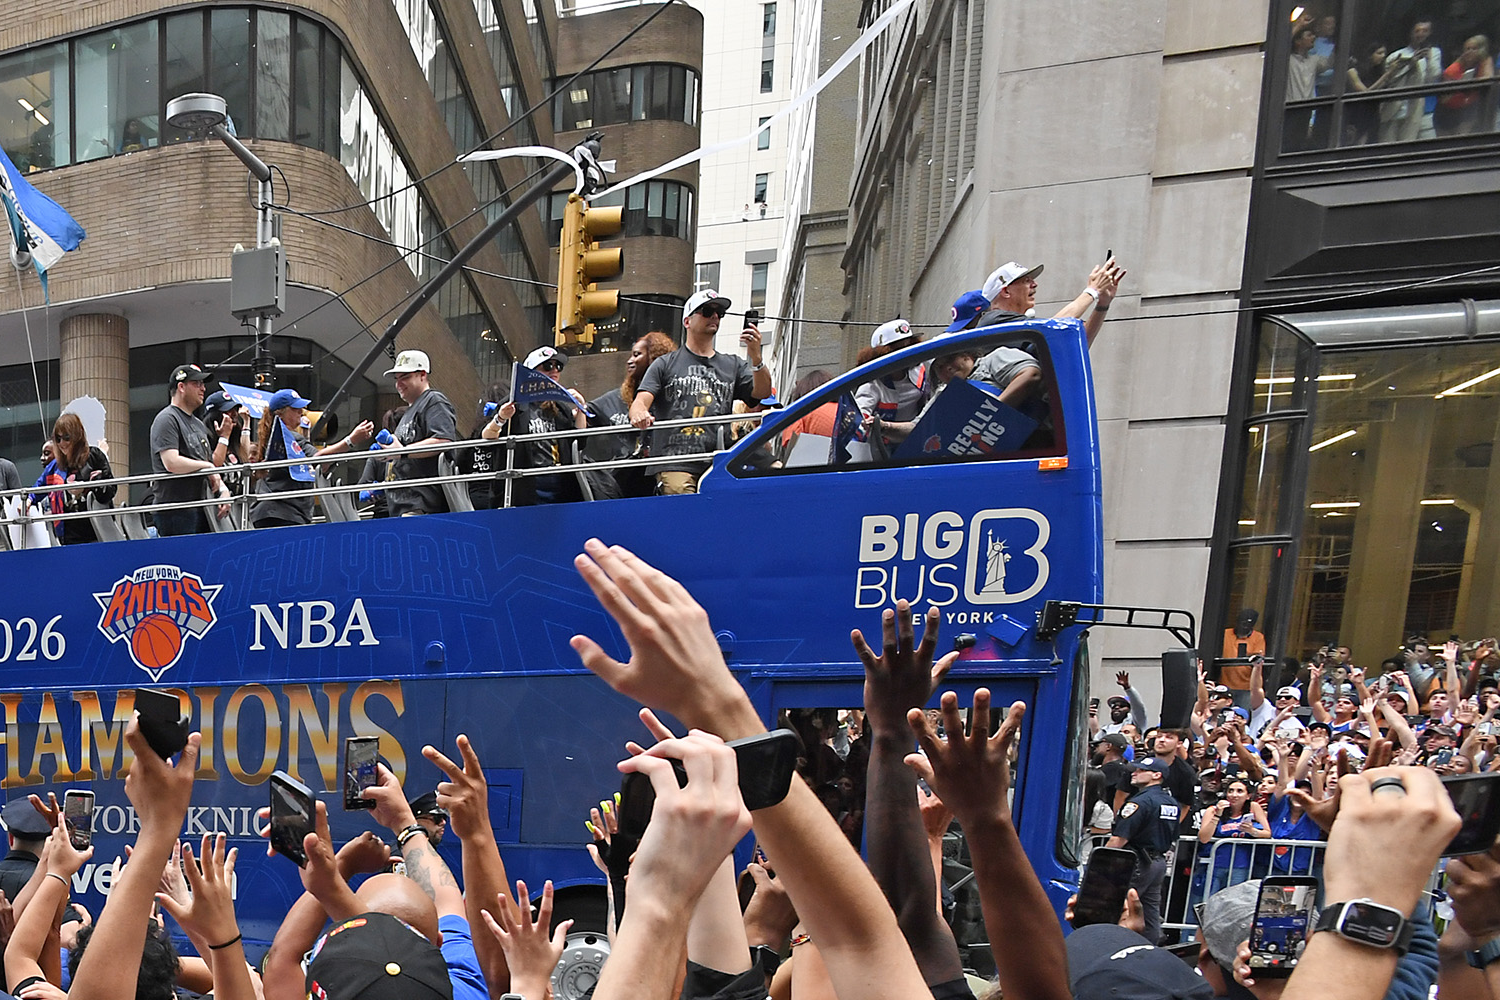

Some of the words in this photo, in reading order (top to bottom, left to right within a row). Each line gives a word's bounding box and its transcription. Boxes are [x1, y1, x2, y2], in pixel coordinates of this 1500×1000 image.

[947, 398, 999, 456] REALLY
[858, 511, 964, 563] BIG
[134, 568, 154, 582] NEW
[155, 567, 181, 580] YORK
[854, 563, 959, 609] BUS
[102, 576, 213, 628] KNICKS
[250, 598, 380, 651] NBA
[946, 611, 994, 624] YORK
[90, 804, 144, 835] YOR
